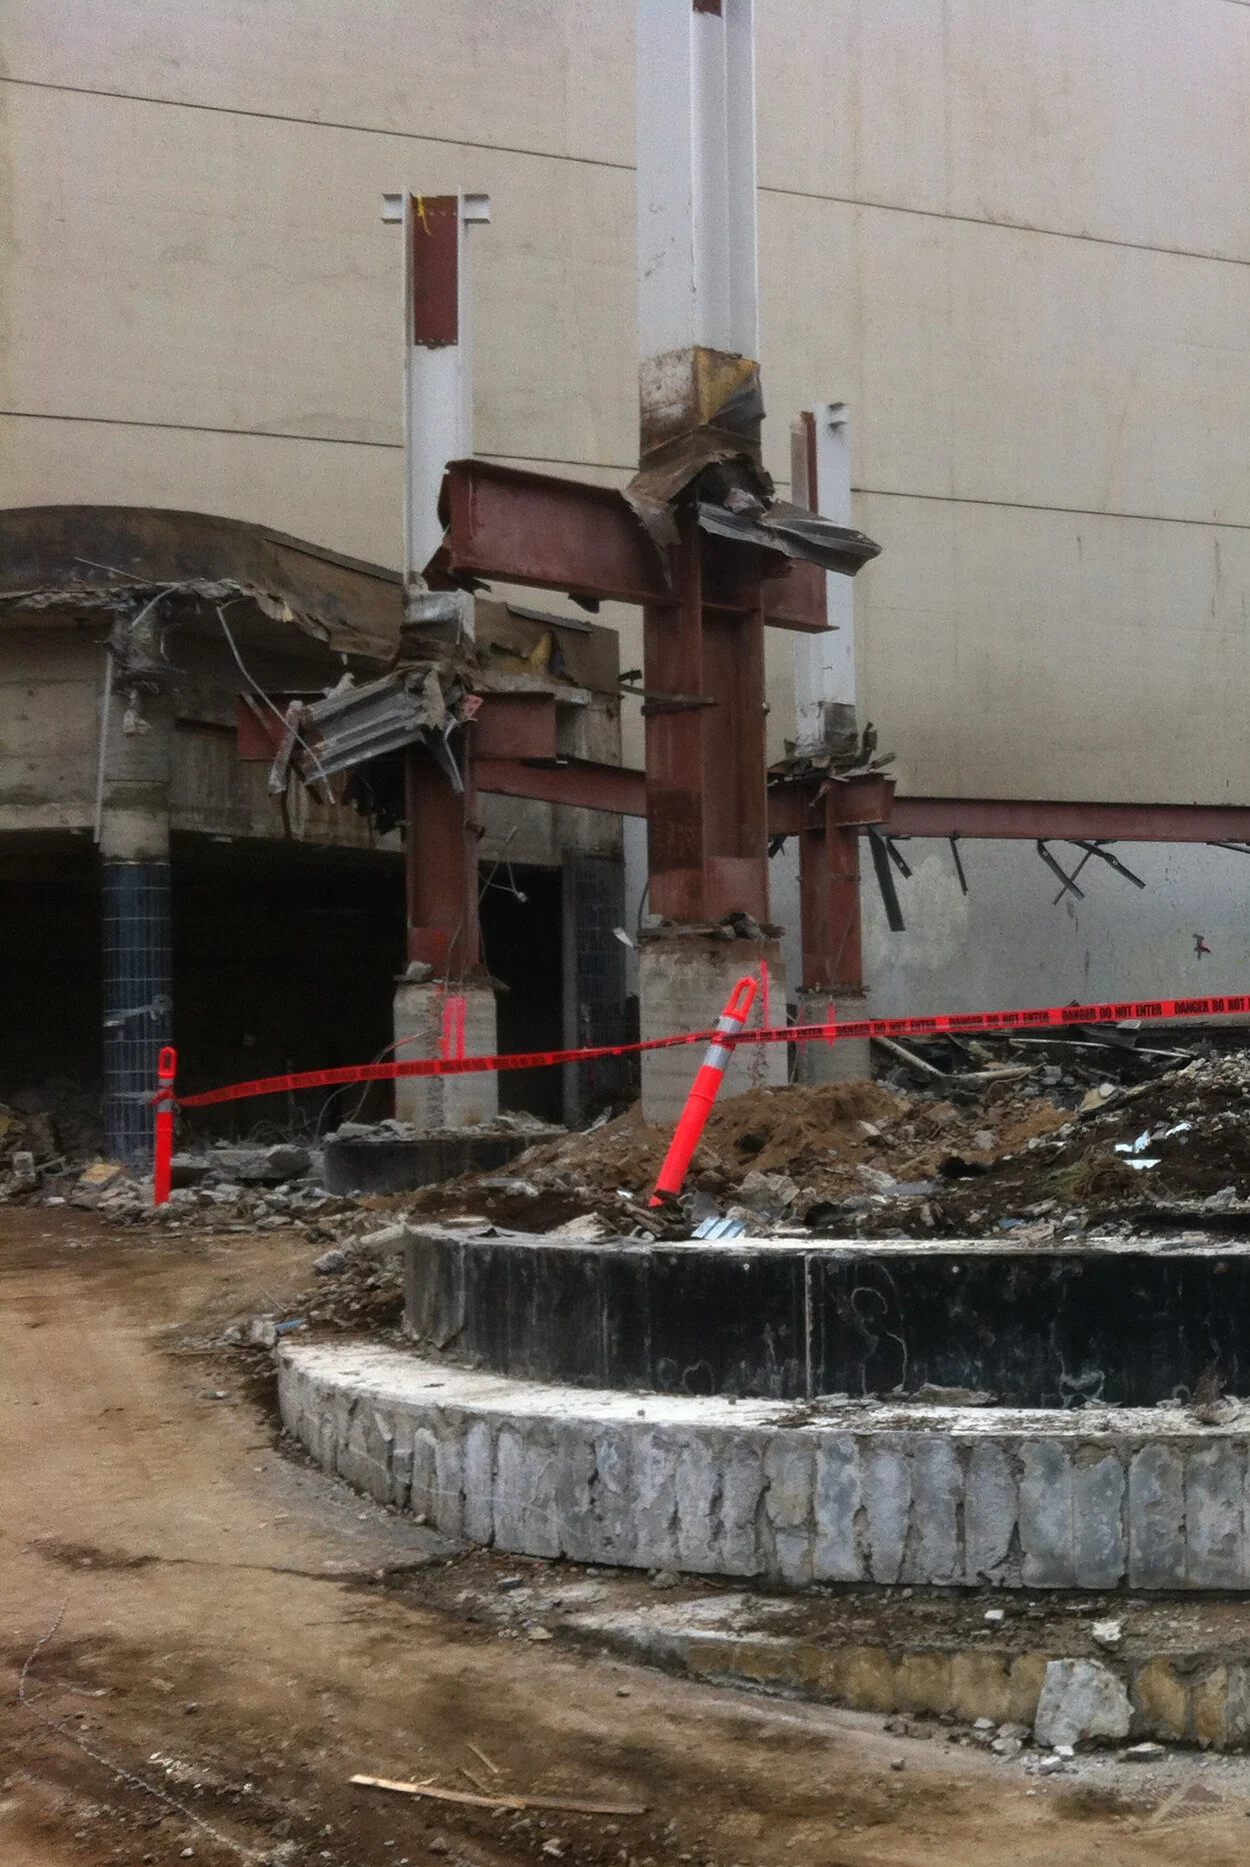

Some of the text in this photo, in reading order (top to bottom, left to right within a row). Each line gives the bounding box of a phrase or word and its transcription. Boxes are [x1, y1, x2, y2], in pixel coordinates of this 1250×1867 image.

[1062, 1003, 1162, 1021] DANGER DO NOT ENTER
[1174, 1000, 1209, 1014] DANGER
[1213, 999, 1225, 1012] DO
[1228, 998, 1245, 1011] NOT
